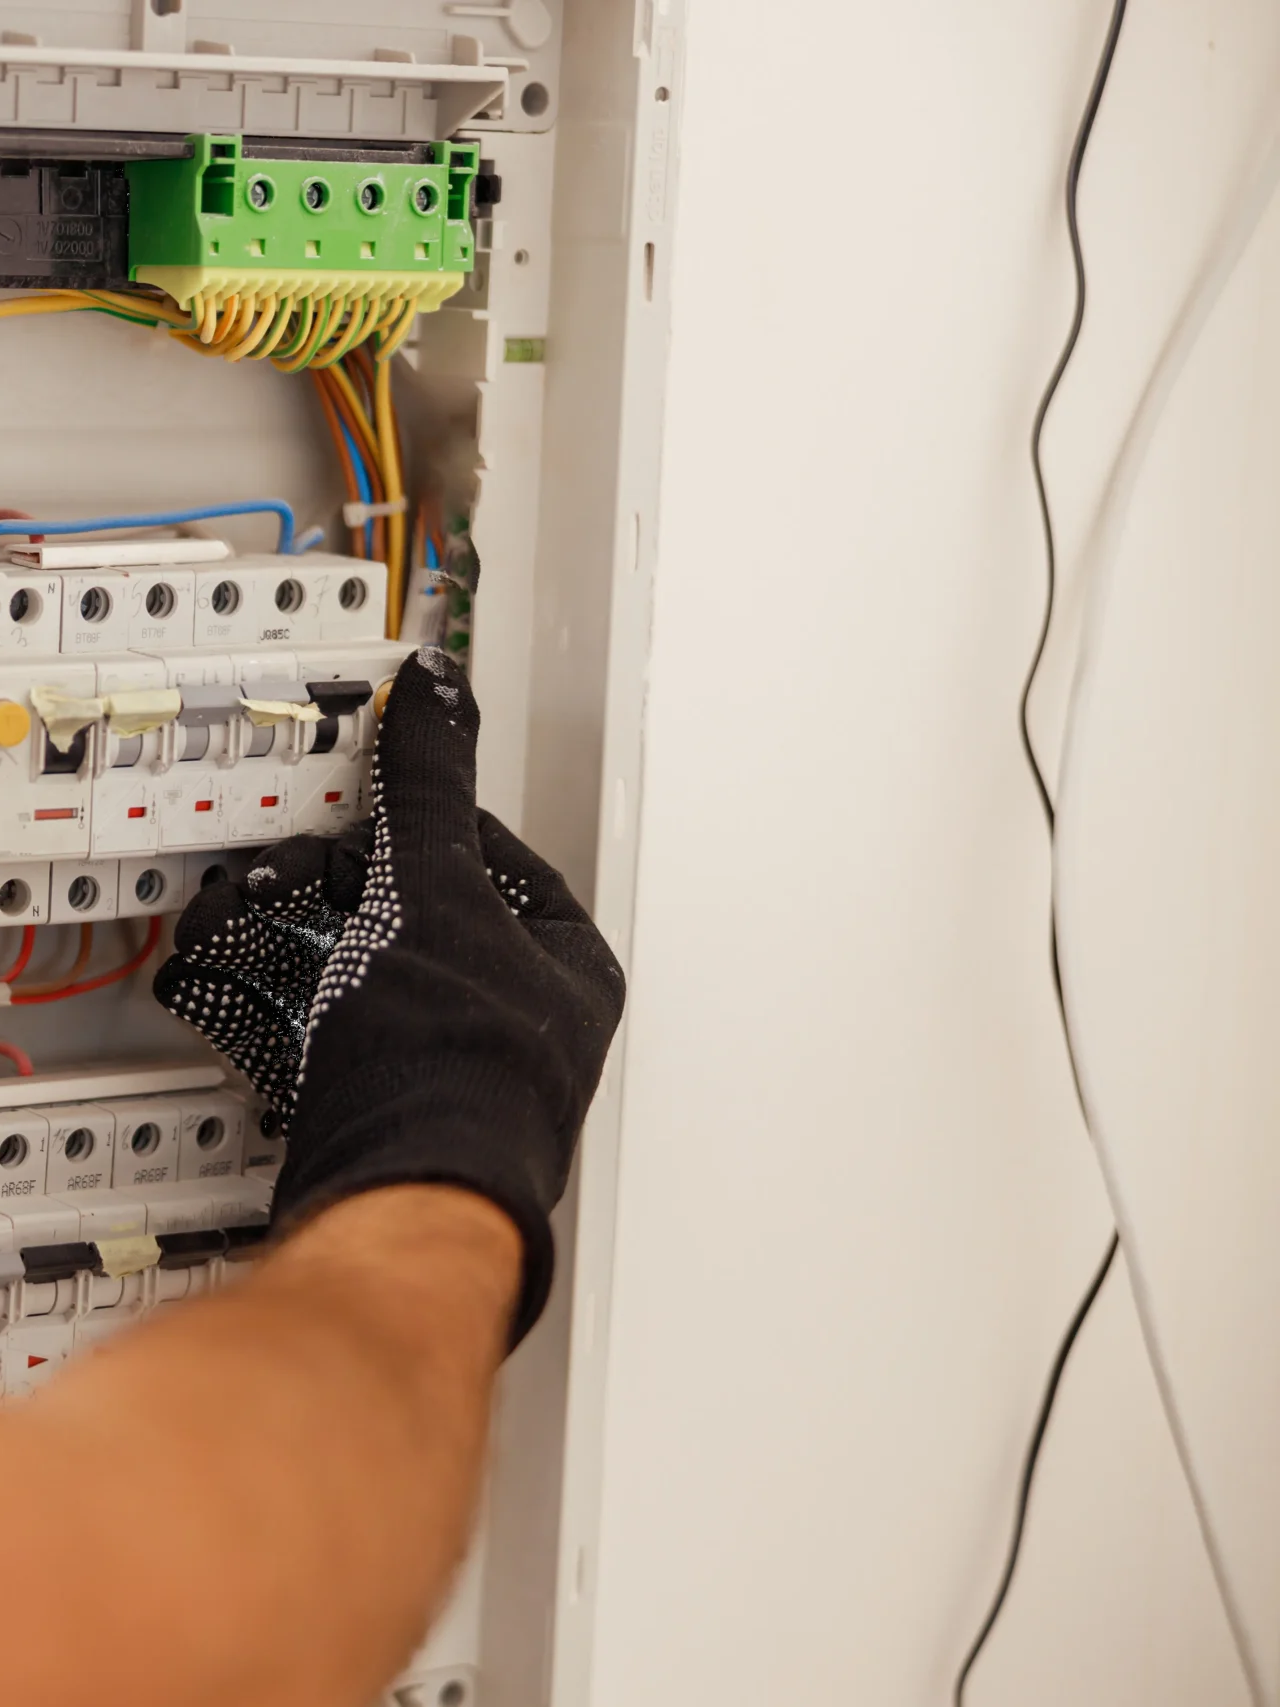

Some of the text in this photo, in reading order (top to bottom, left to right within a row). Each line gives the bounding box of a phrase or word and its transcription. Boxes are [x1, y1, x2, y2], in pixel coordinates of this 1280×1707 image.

[47, 583, 56, 594] N
[32, 905, 40, 917] N
[106, 897, 114, 911] 2
[172, 1125, 177, 1141] 1
[40, 1137, 45, 1152] 1
[66, 1173, 102, 1190] AR68F
[133, 1166, 169, 1185] AR68F
[1, 1179, 37, 1198] AR68F
